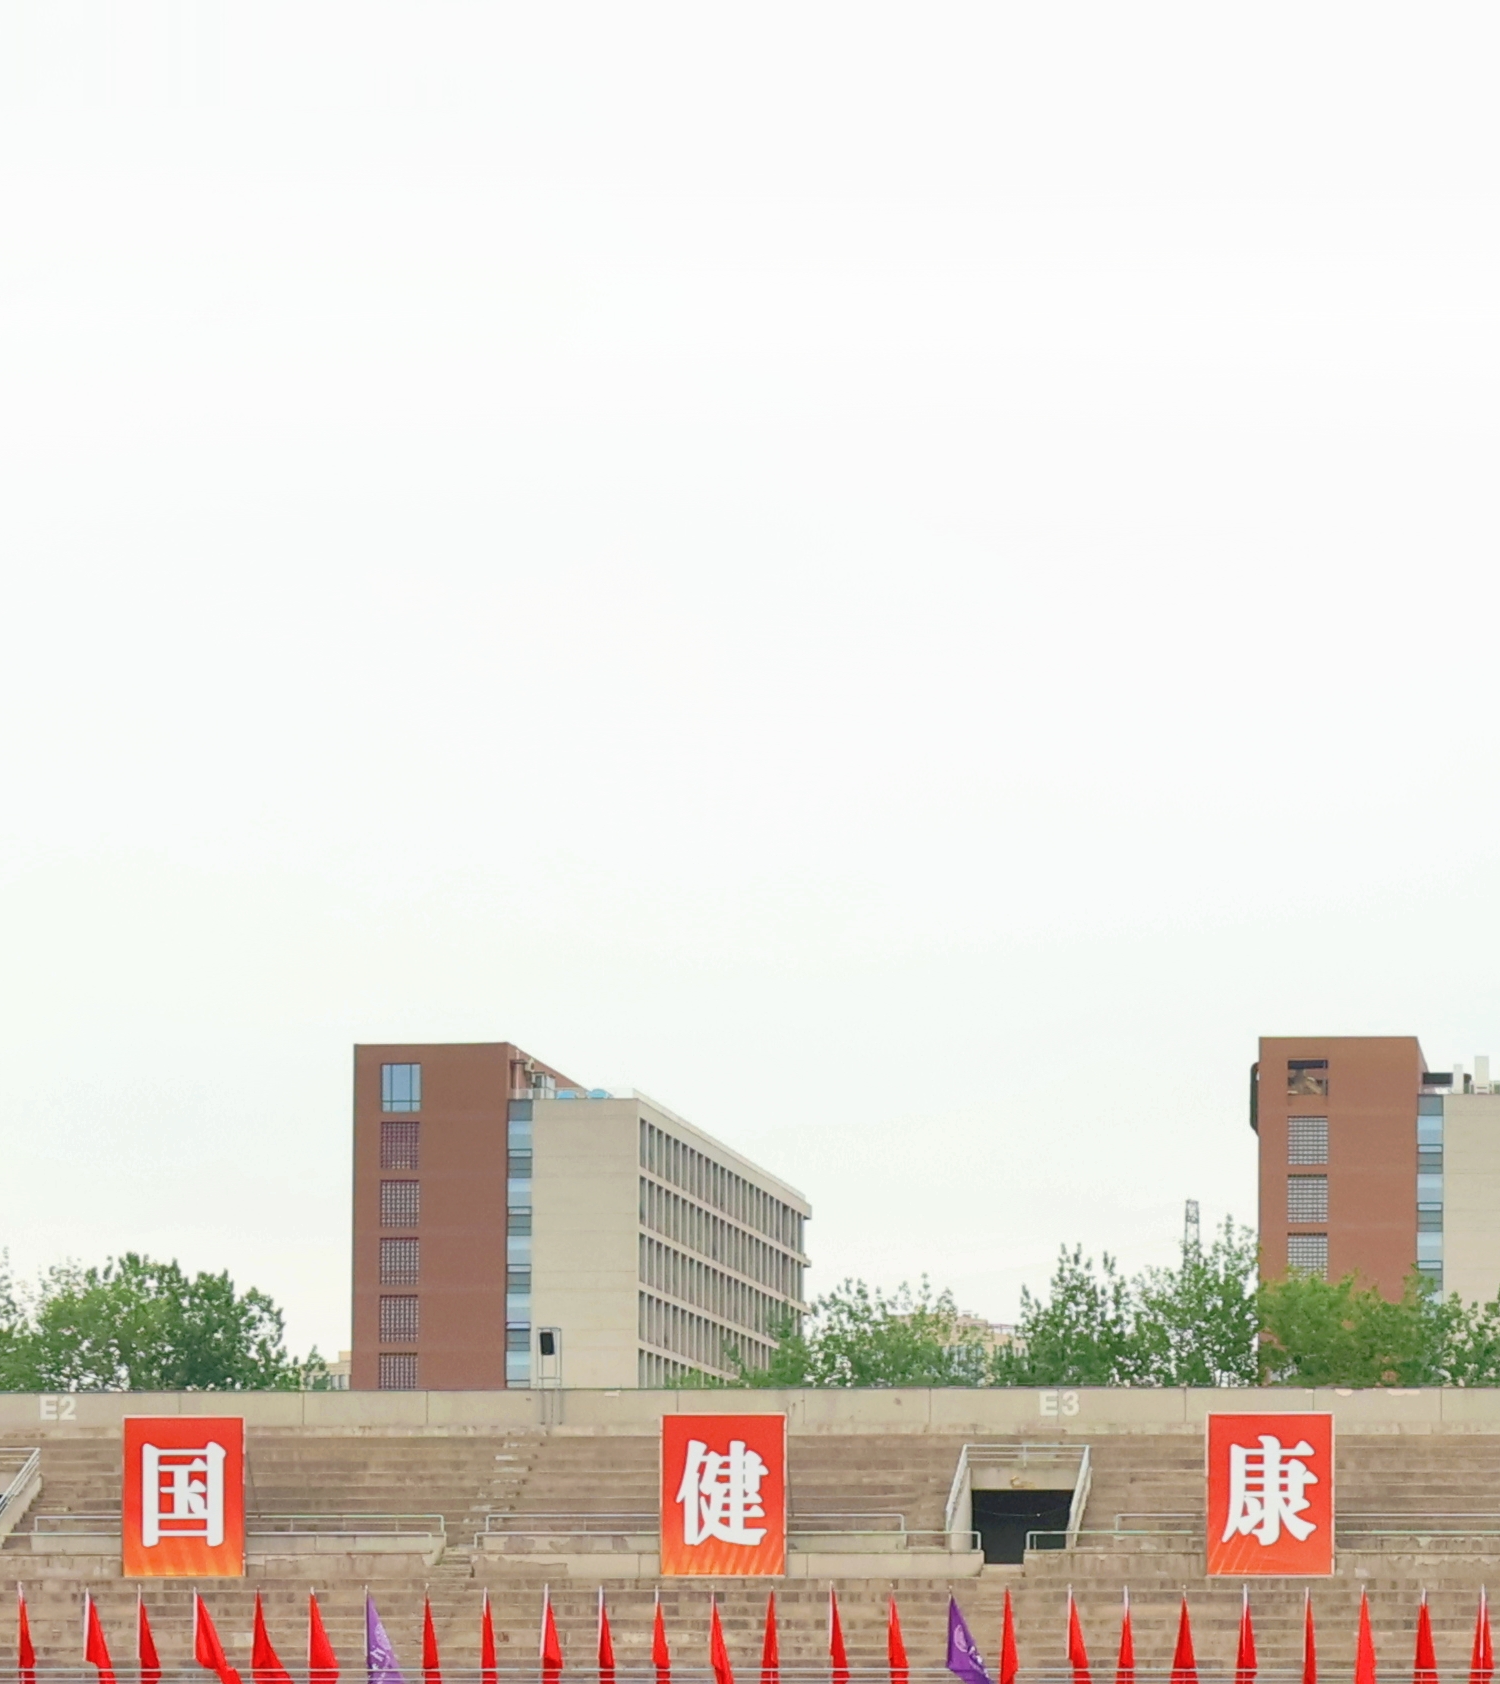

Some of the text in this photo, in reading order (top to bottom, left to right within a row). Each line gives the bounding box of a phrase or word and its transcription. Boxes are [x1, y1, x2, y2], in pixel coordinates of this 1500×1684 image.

[39, 1395, 76, 1421] E2
[1039, 1390, 1079, 1416] E3
[138, 1442, 226, 1550] 国
[677, 1440, 768, 1547] 健
[1222, 1436, 1317, 1547] 康
